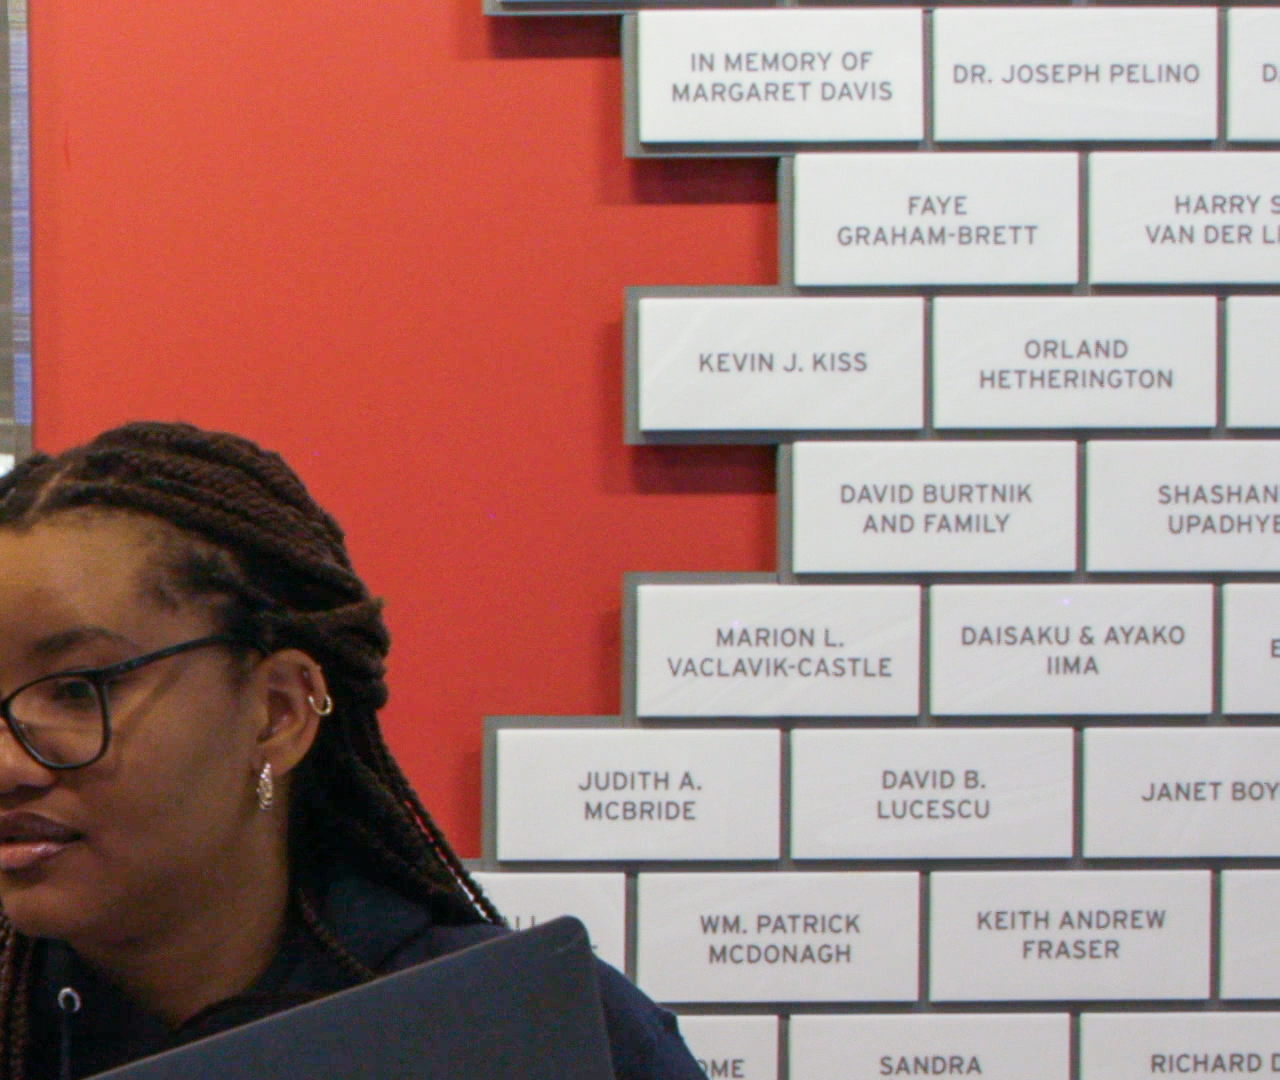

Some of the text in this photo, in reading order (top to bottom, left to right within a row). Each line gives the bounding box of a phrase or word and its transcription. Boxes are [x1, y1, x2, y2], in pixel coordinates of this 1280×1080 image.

[691, 50, 873, 73] IN MEMORY OF
[953, 63, 1201, 84] DR. JOSEPH PELINO
[671, 80, 893, 103] MARGARET DAVIS
[908, 195, 968, 216] FAYE
[1174, 194, 1261, 214] HARRY
[837, 224, 1038, 247] GRAHAM-BRETT
[1145, 224, 1253, 245] VAN DER
[1024, 339, 1129, 360] ORLAND
[699, 351, 868, 373] KEVIN KISS
[979, 368, 1174, 390] HETHERINGTON
[840, 483, 1033, 505] DAVID BURTNIK
[862, 513, 1010, 534] AND FAMILY
[716, 627, 815, 648] MARION
[961, 624, 1186, 646] DAISAKU AYAKO
[667, 656, 893, 678] VACLAVIK-CASTLE
[1047, 655, 1100, 675] IIMA
[578, 770, 670, 792] JUDITH
[881, 769, 956, 790] DAVID
[1141, 781, 1223, 802] JANET
[584, 800, 696, 821] MCBRIDE
[877, 798, 990, 820] LUCESCU
[700, 913, 861, 935] WM. PATRICK
[977, 909, 1167, 931] KEITH ANDREW
[708, 943, 851, 965] MCDONAGH
[1022, 939, 1120, 960] FRASER
[879, 1055, 982, 1076] SANDRA
[1150, 1052, 1263, 1074] RICHARD
